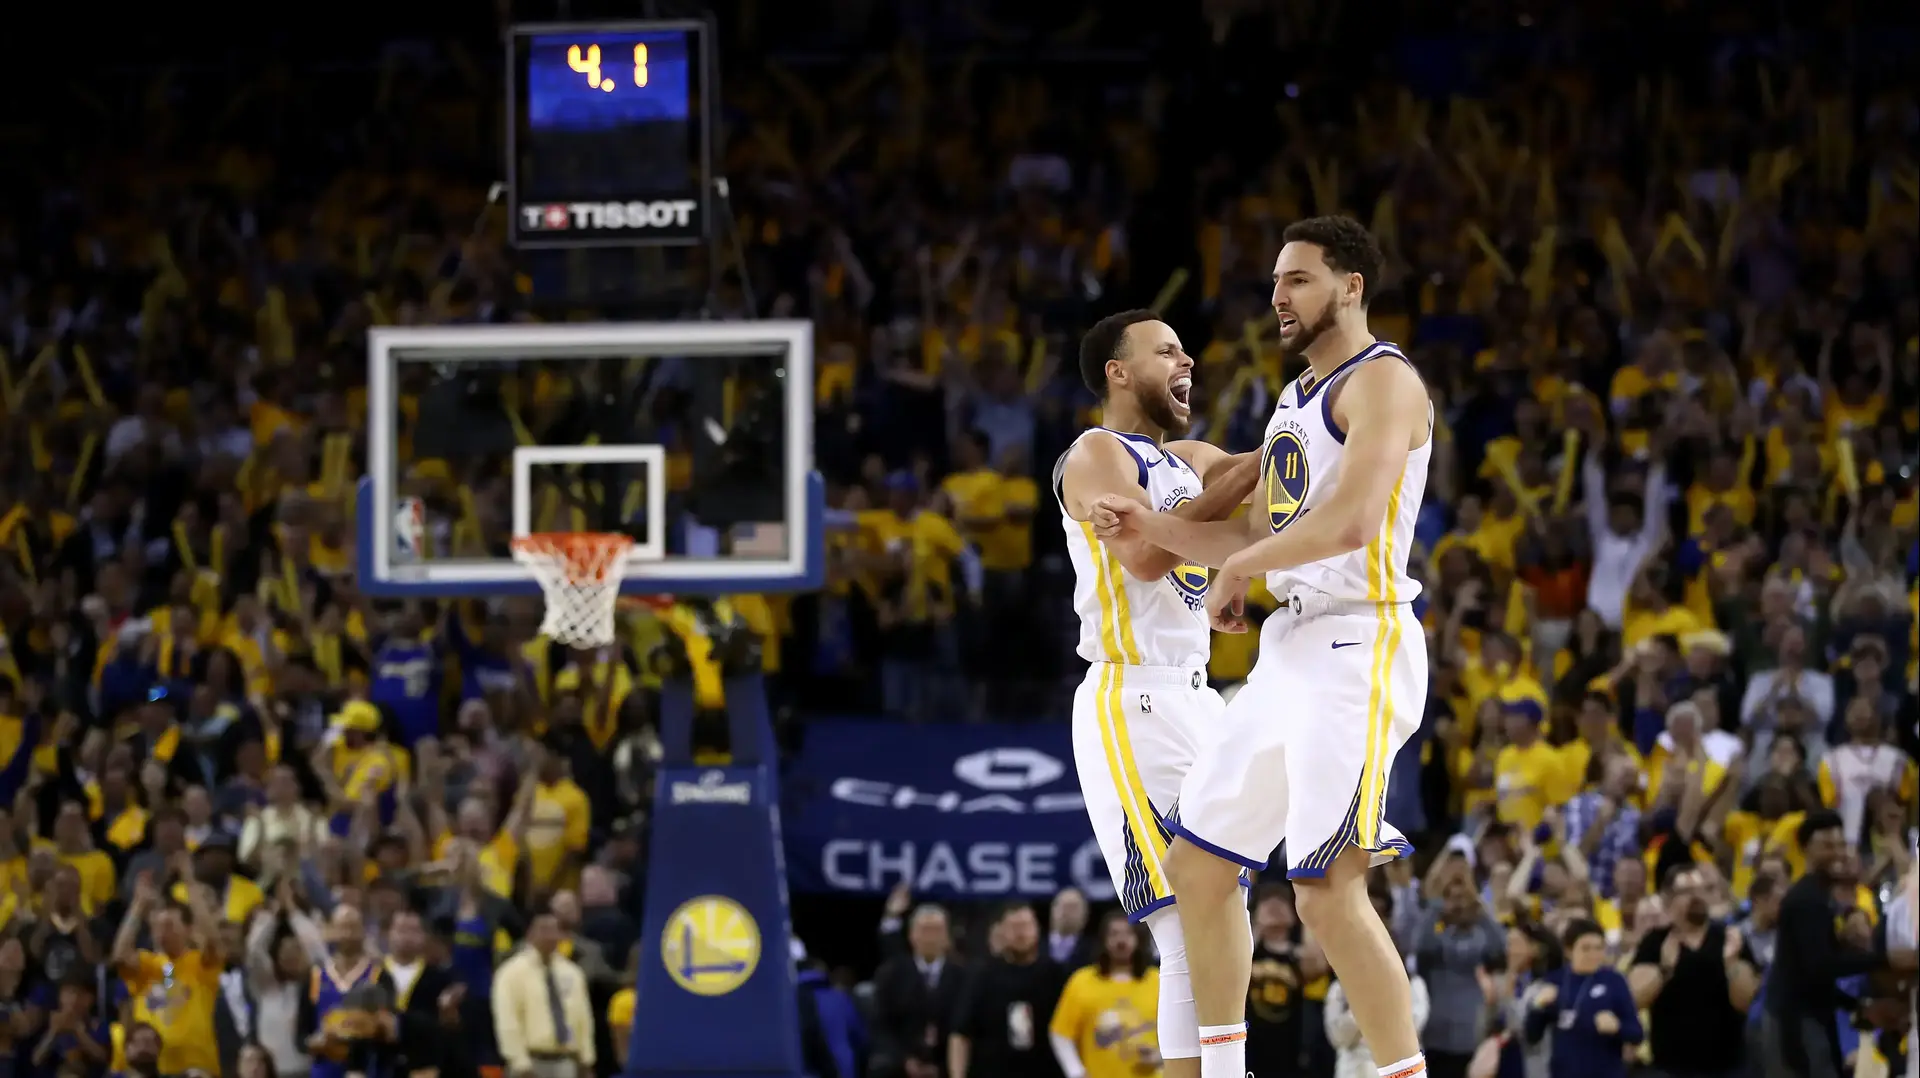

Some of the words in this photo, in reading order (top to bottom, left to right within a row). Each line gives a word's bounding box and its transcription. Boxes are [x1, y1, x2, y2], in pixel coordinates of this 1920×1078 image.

[567, 43, 648, 92] 4.1
[569, 200, 697, 229] TISSOT
[1289, 420, 1311, 450] STATE
[1285, 452, 1298, 479] 11
[822, 839, 1058, 893] CHASE
